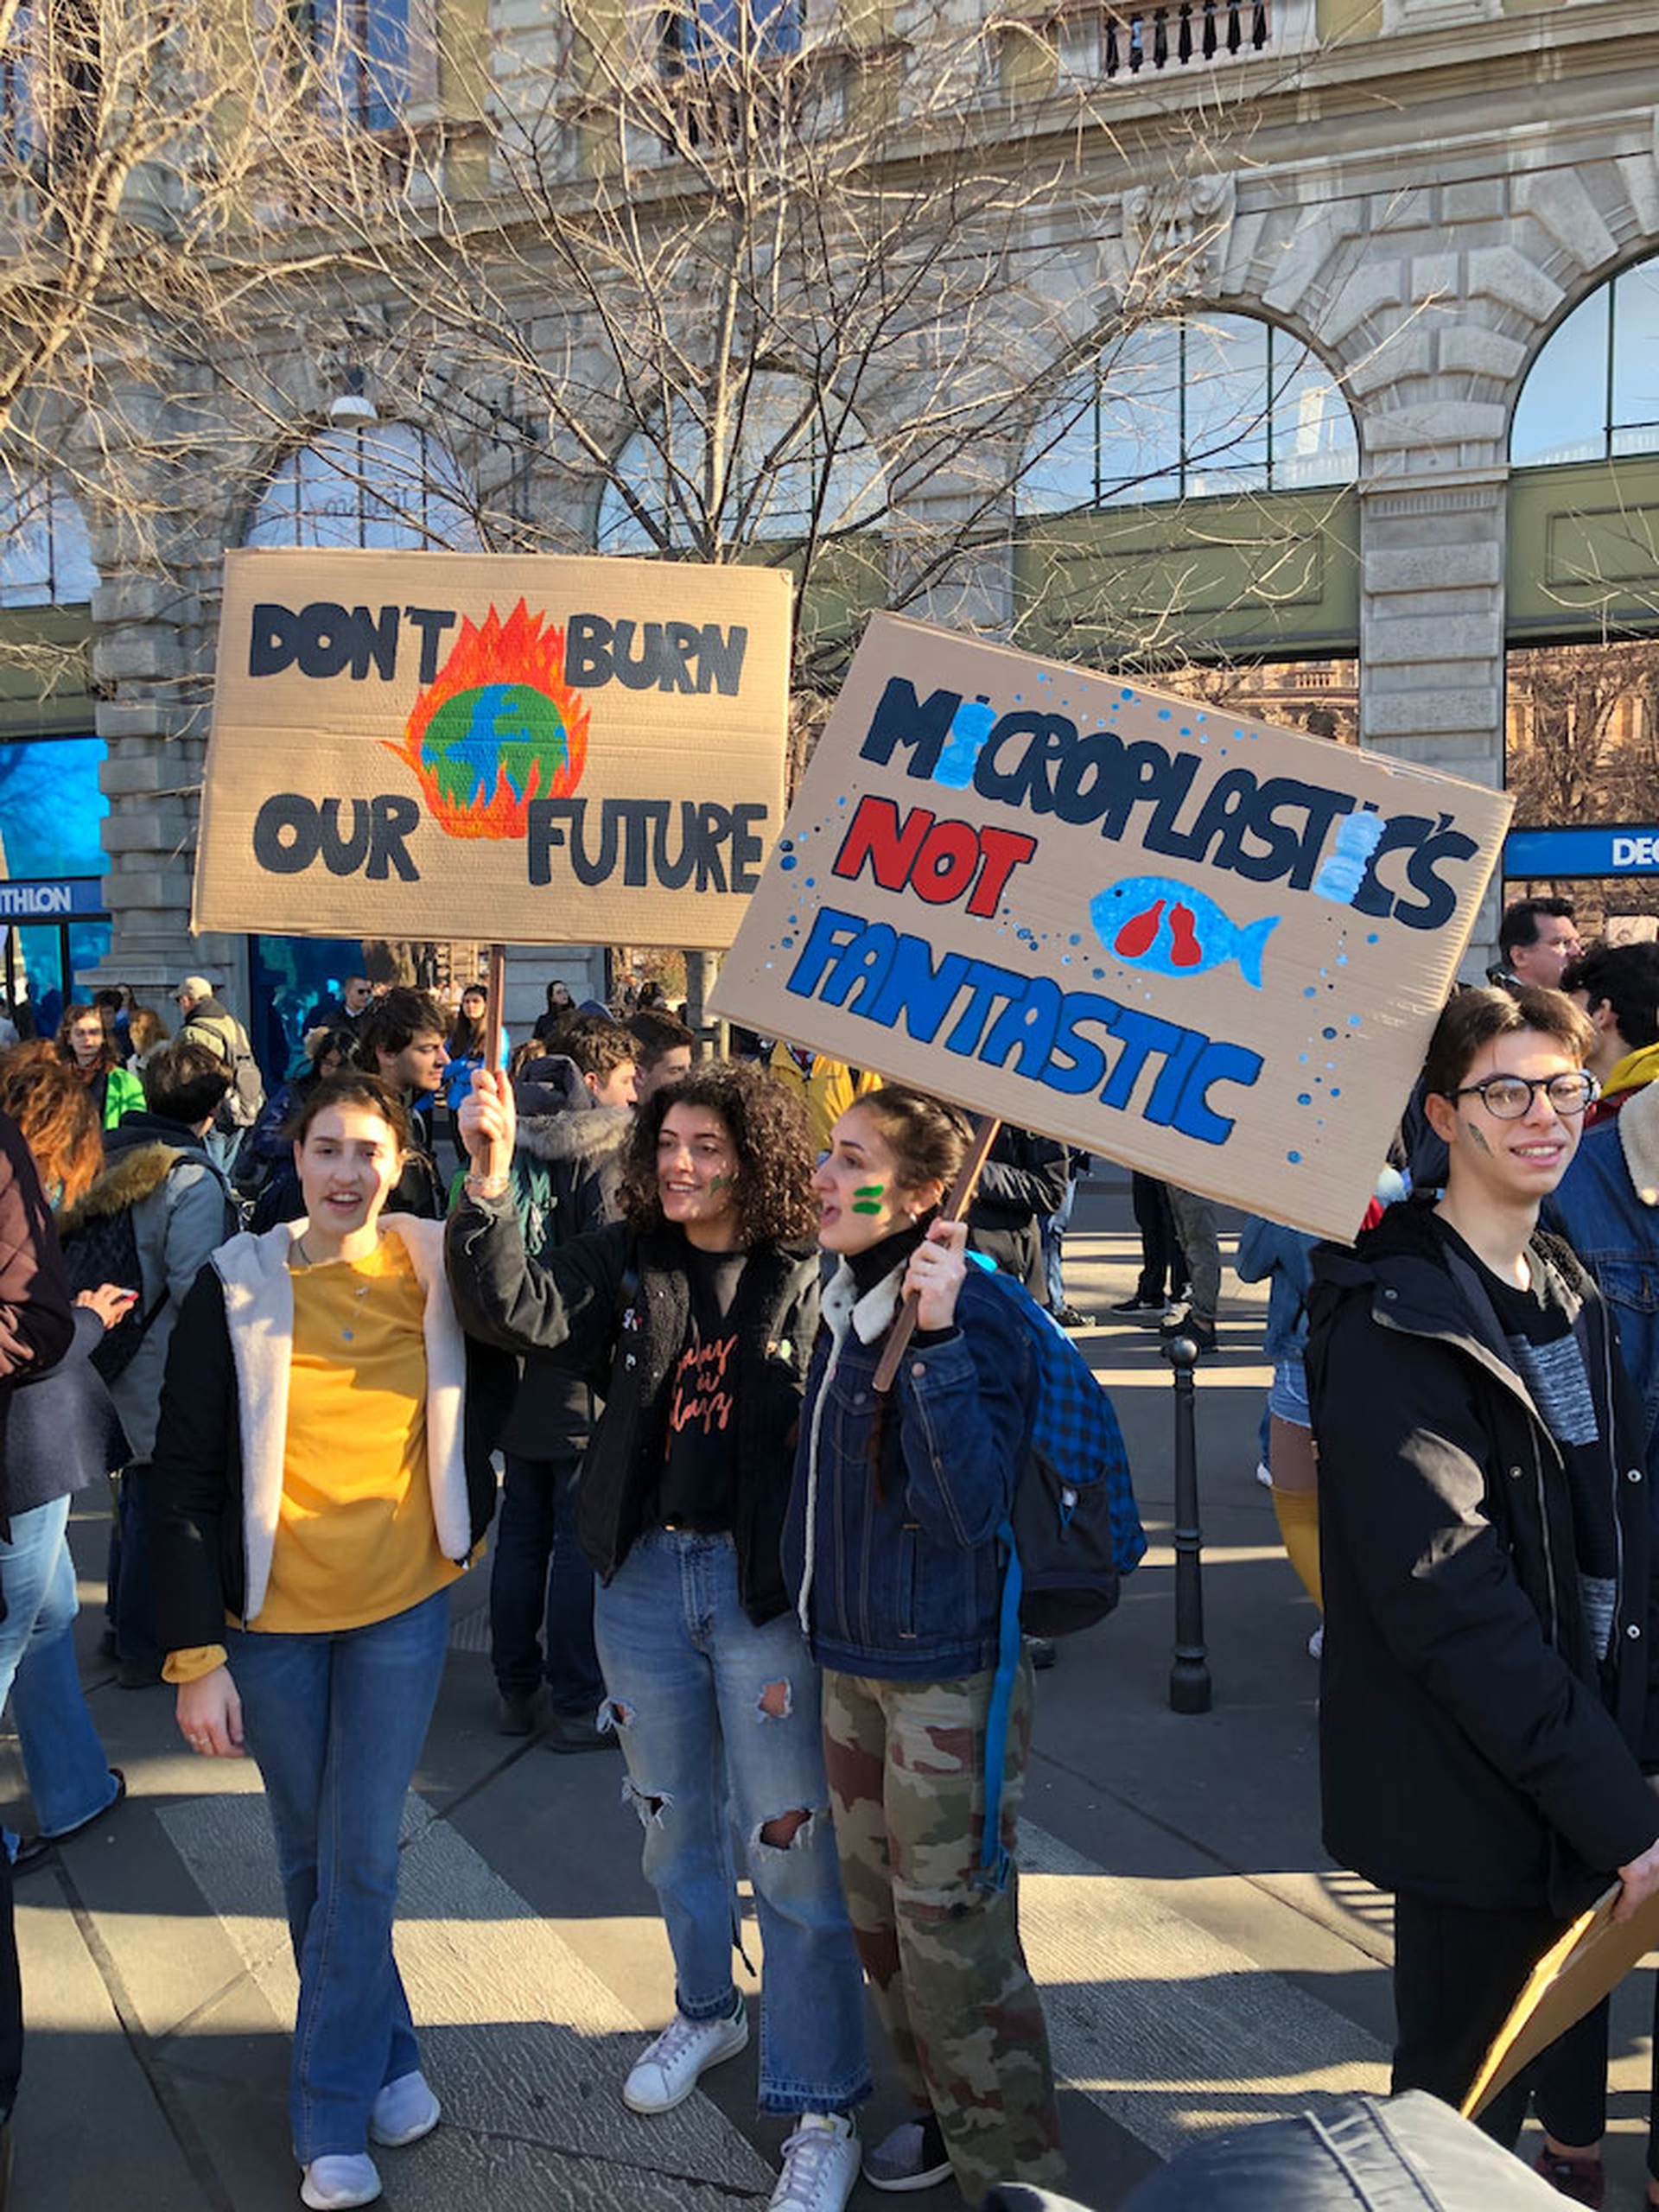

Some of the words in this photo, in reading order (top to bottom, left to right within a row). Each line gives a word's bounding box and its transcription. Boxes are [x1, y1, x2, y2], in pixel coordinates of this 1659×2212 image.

[249, 603, 456, 684] DON'T
[564, 613, 748, 696] BURN
[252, 793, 421, 881] OUR
[527, 798, 767, 893] FUTURE
[833, 794, 1037, 918] NOT
[785, 906, 1264, 1146] FANTASTIC
